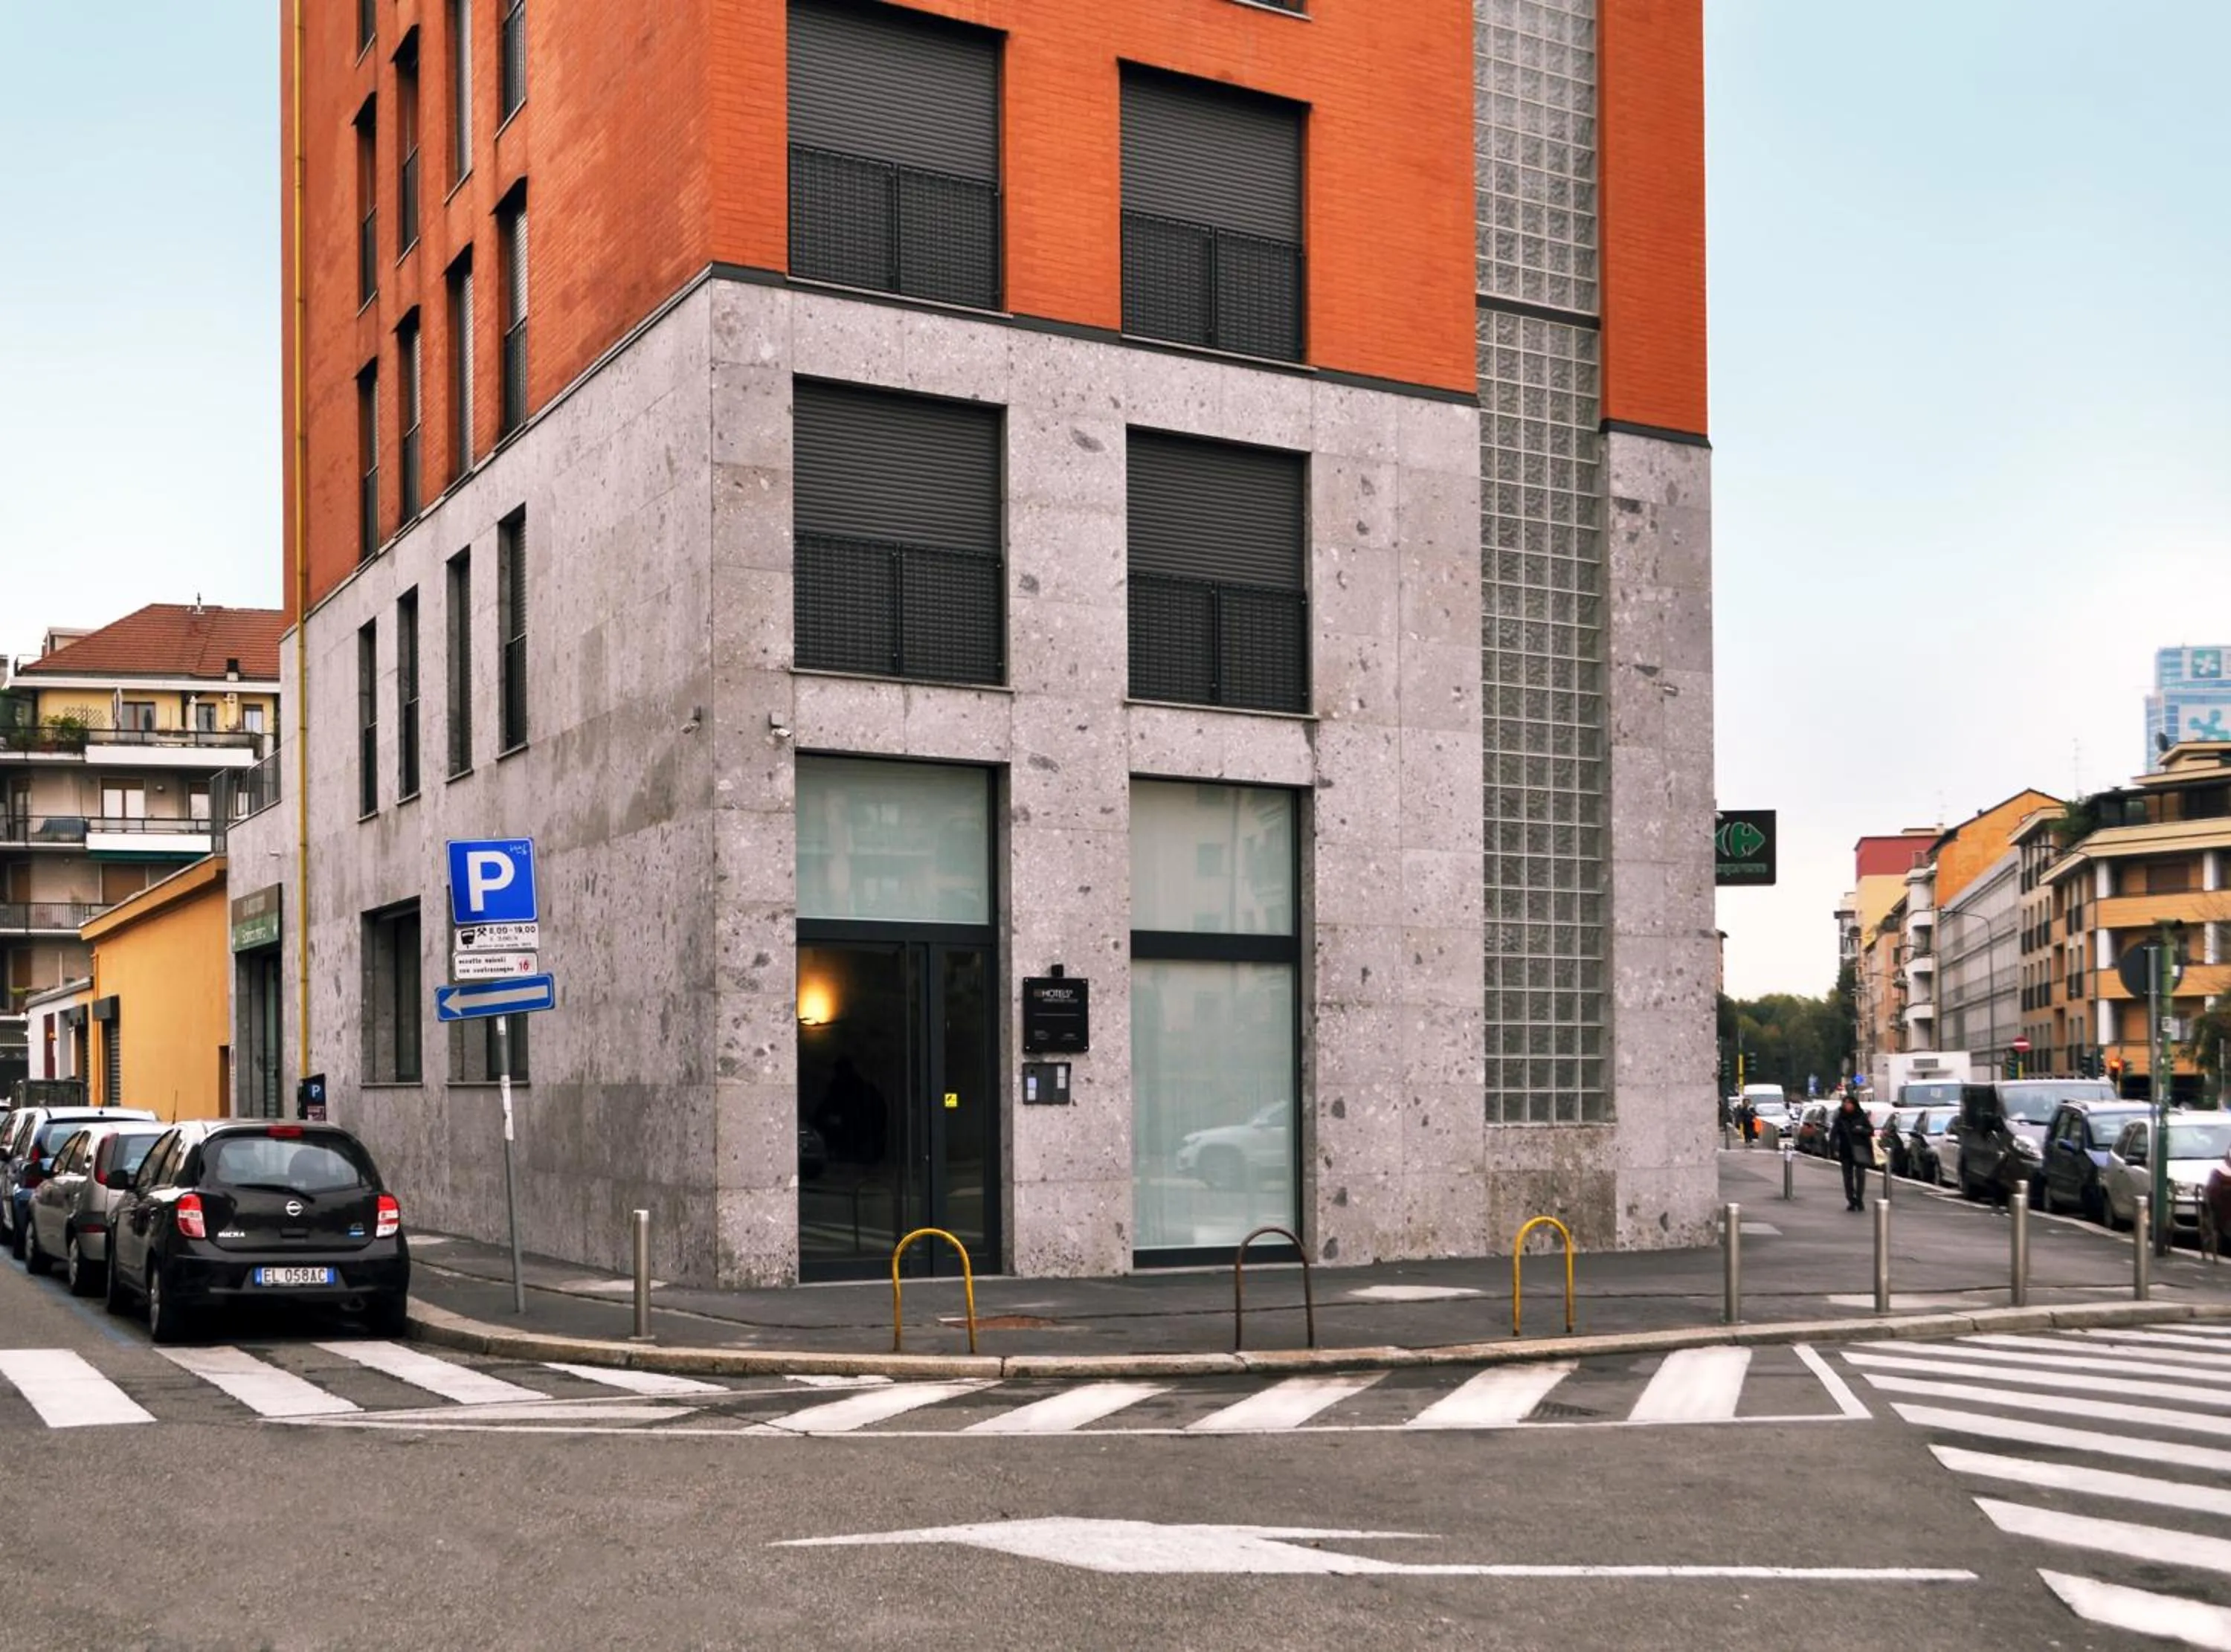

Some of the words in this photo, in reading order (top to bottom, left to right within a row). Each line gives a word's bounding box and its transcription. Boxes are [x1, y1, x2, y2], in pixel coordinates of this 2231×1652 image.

[467, 851, 515, 912] P
[312, 1085, 321, 1098] P
[263, 1268, 280, 1282] EL
